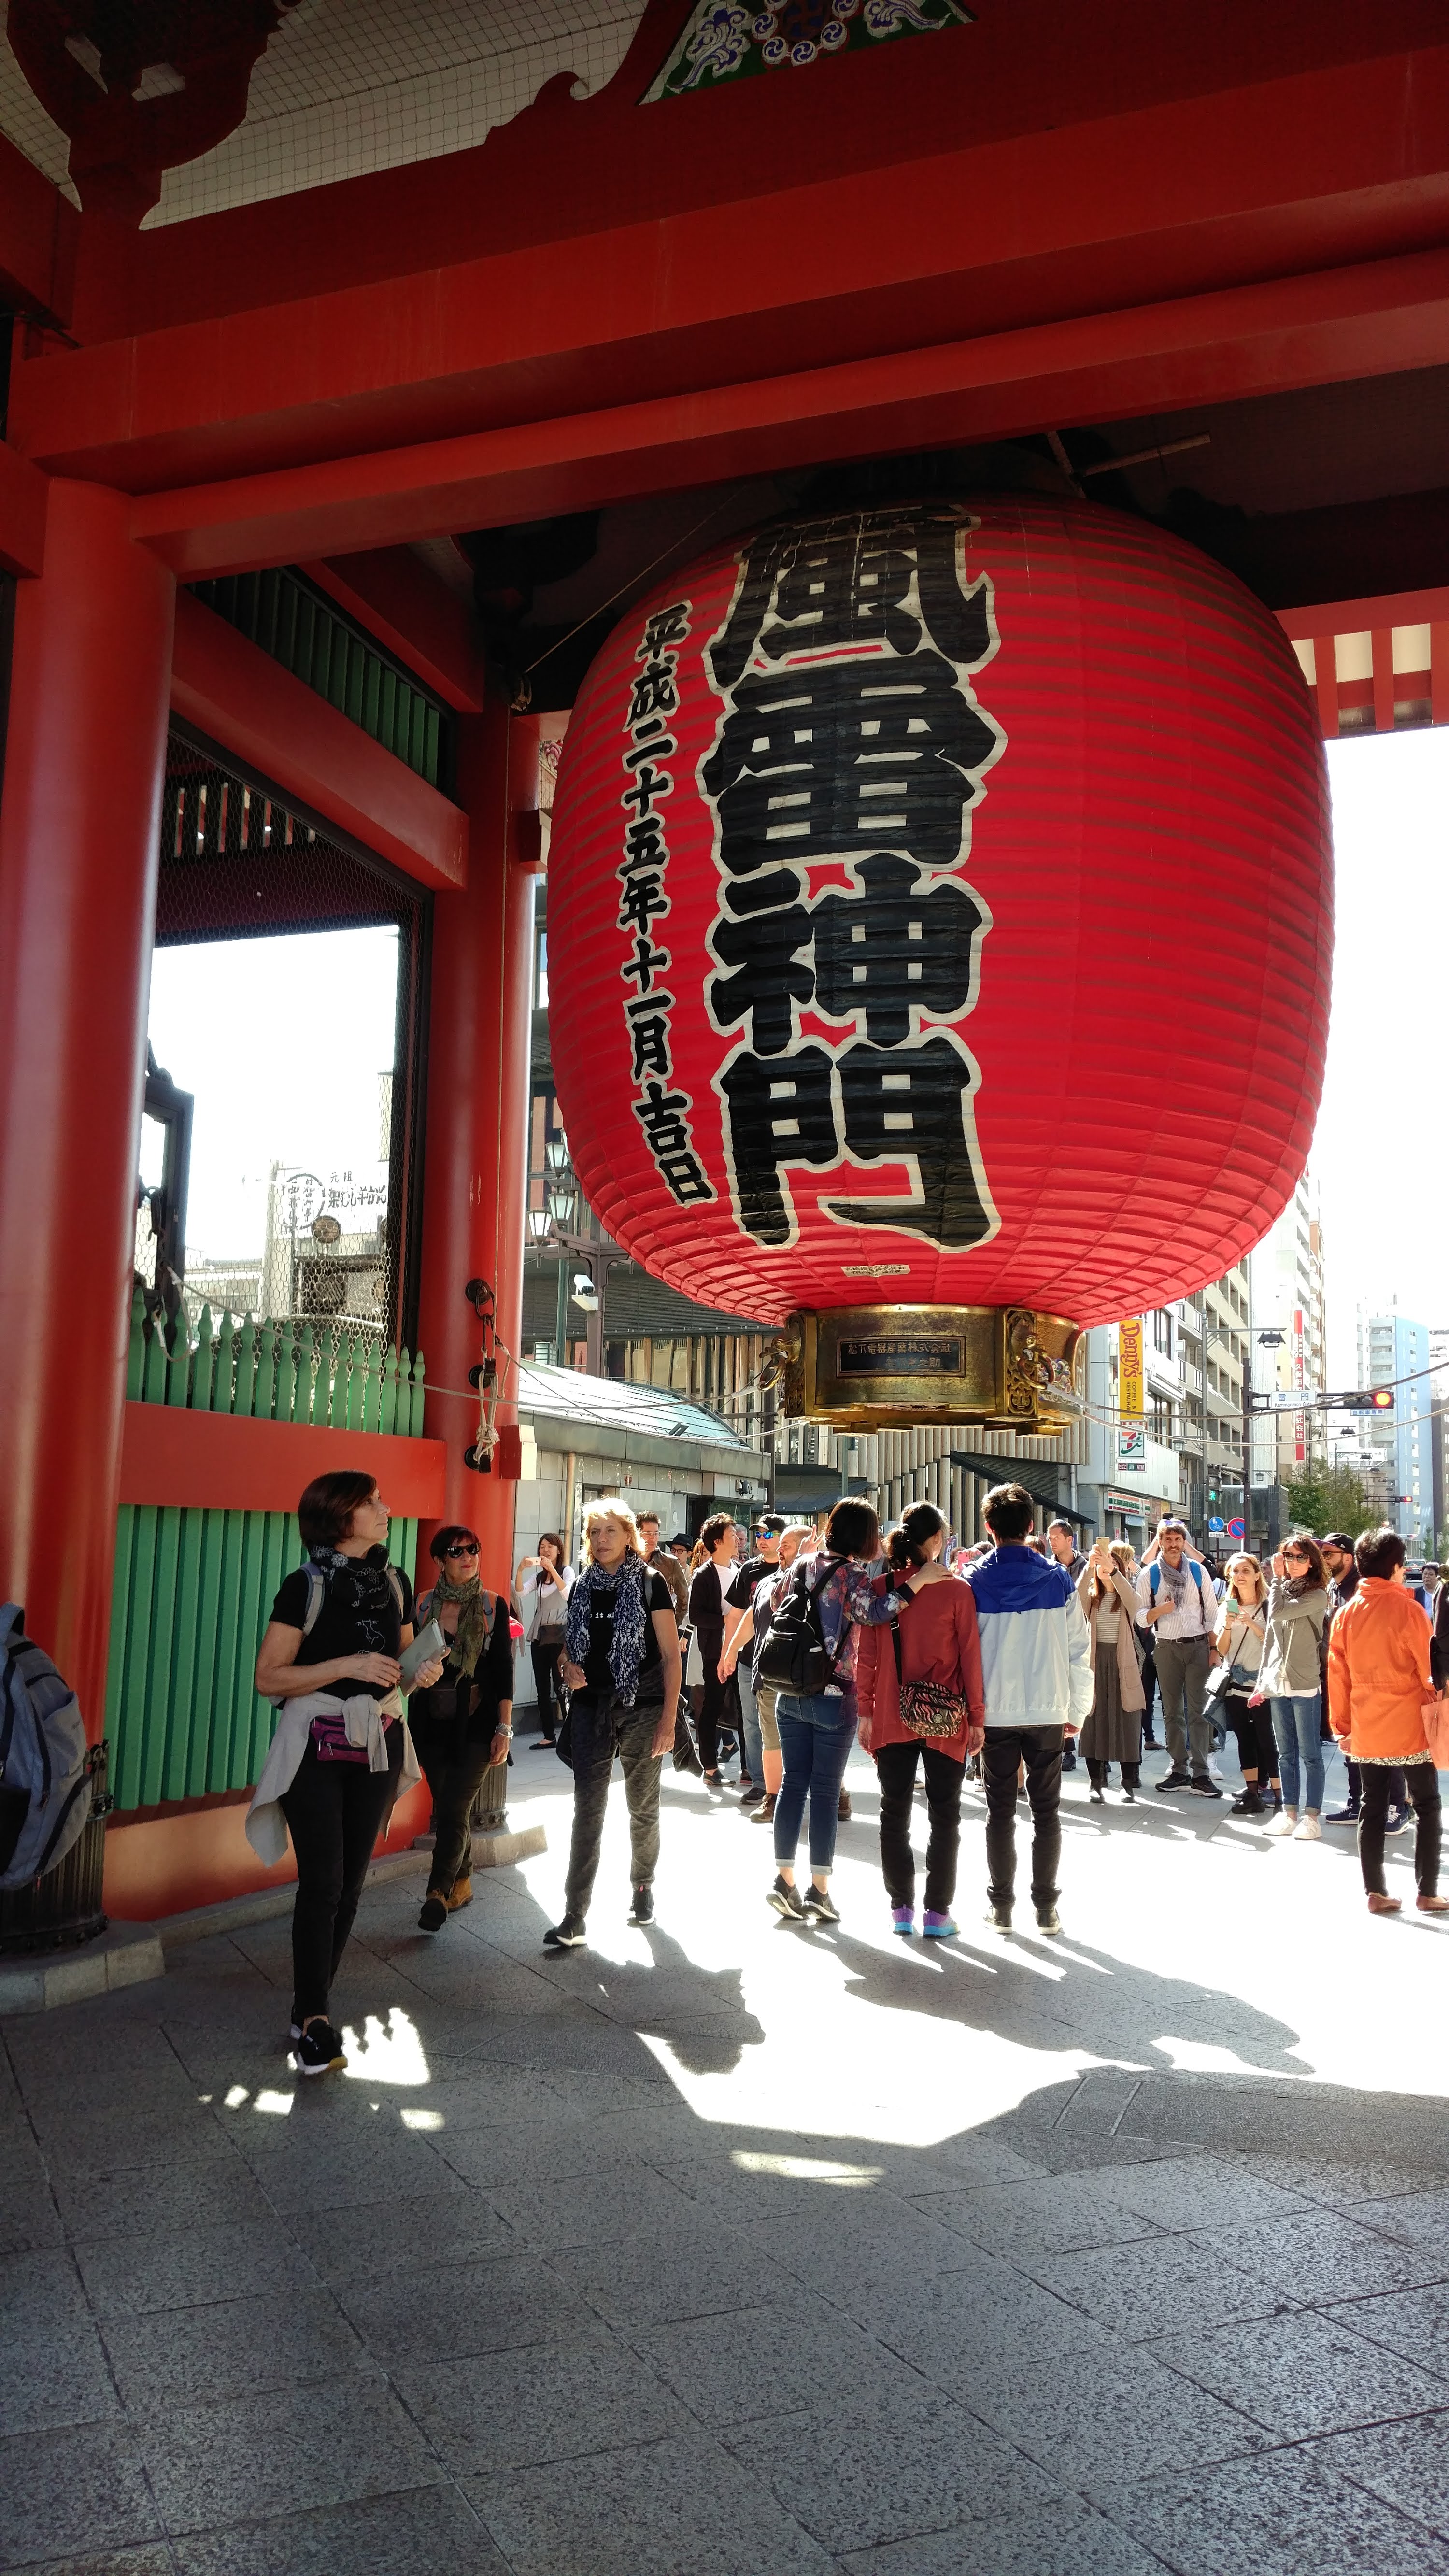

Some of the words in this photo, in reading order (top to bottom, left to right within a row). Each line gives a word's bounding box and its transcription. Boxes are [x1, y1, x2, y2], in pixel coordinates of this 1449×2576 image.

[618, 602, 714, 1204] 平成二十五年十一月吉日
[699, 506, 1004, 1250] 風雷神門
[848, 1342, 952, 1354] 松下電器産業株式会社
[1120, 1323, 1142, 1378] Denny's
